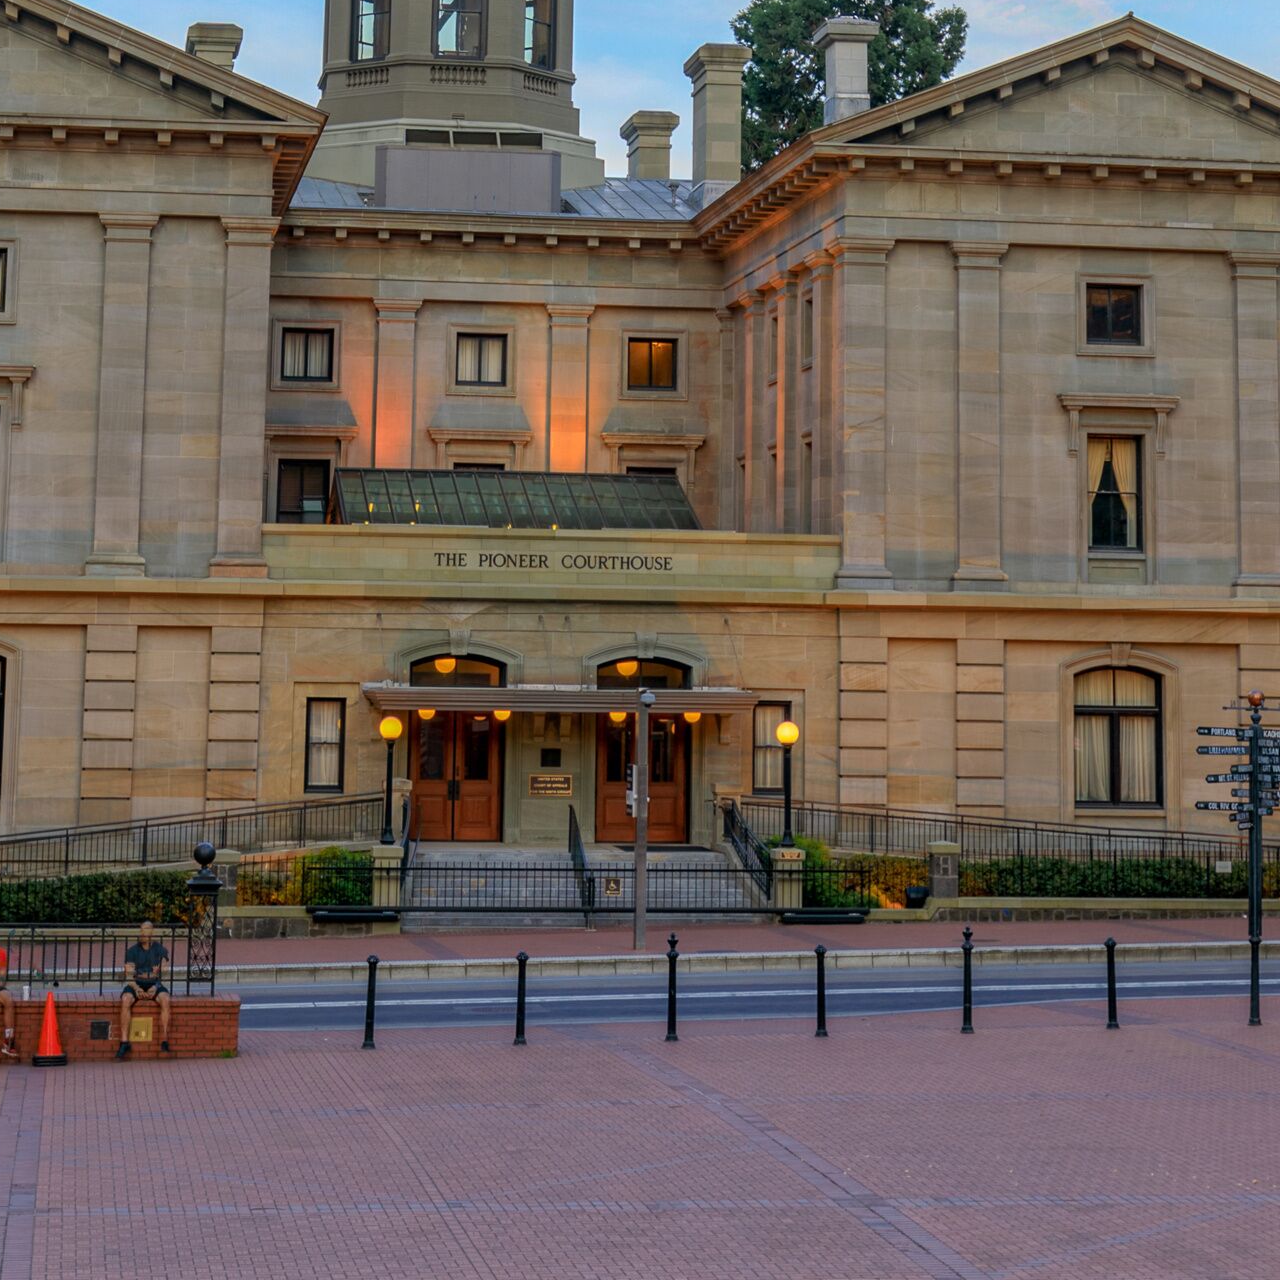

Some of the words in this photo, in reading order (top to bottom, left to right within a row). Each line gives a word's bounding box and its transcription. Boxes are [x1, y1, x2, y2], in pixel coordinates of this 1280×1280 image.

[434, 552, 467, 567] THE
[479, 553, 549, 569] PIONEER
[561, 554, 673, 571] COURTHOUSE
